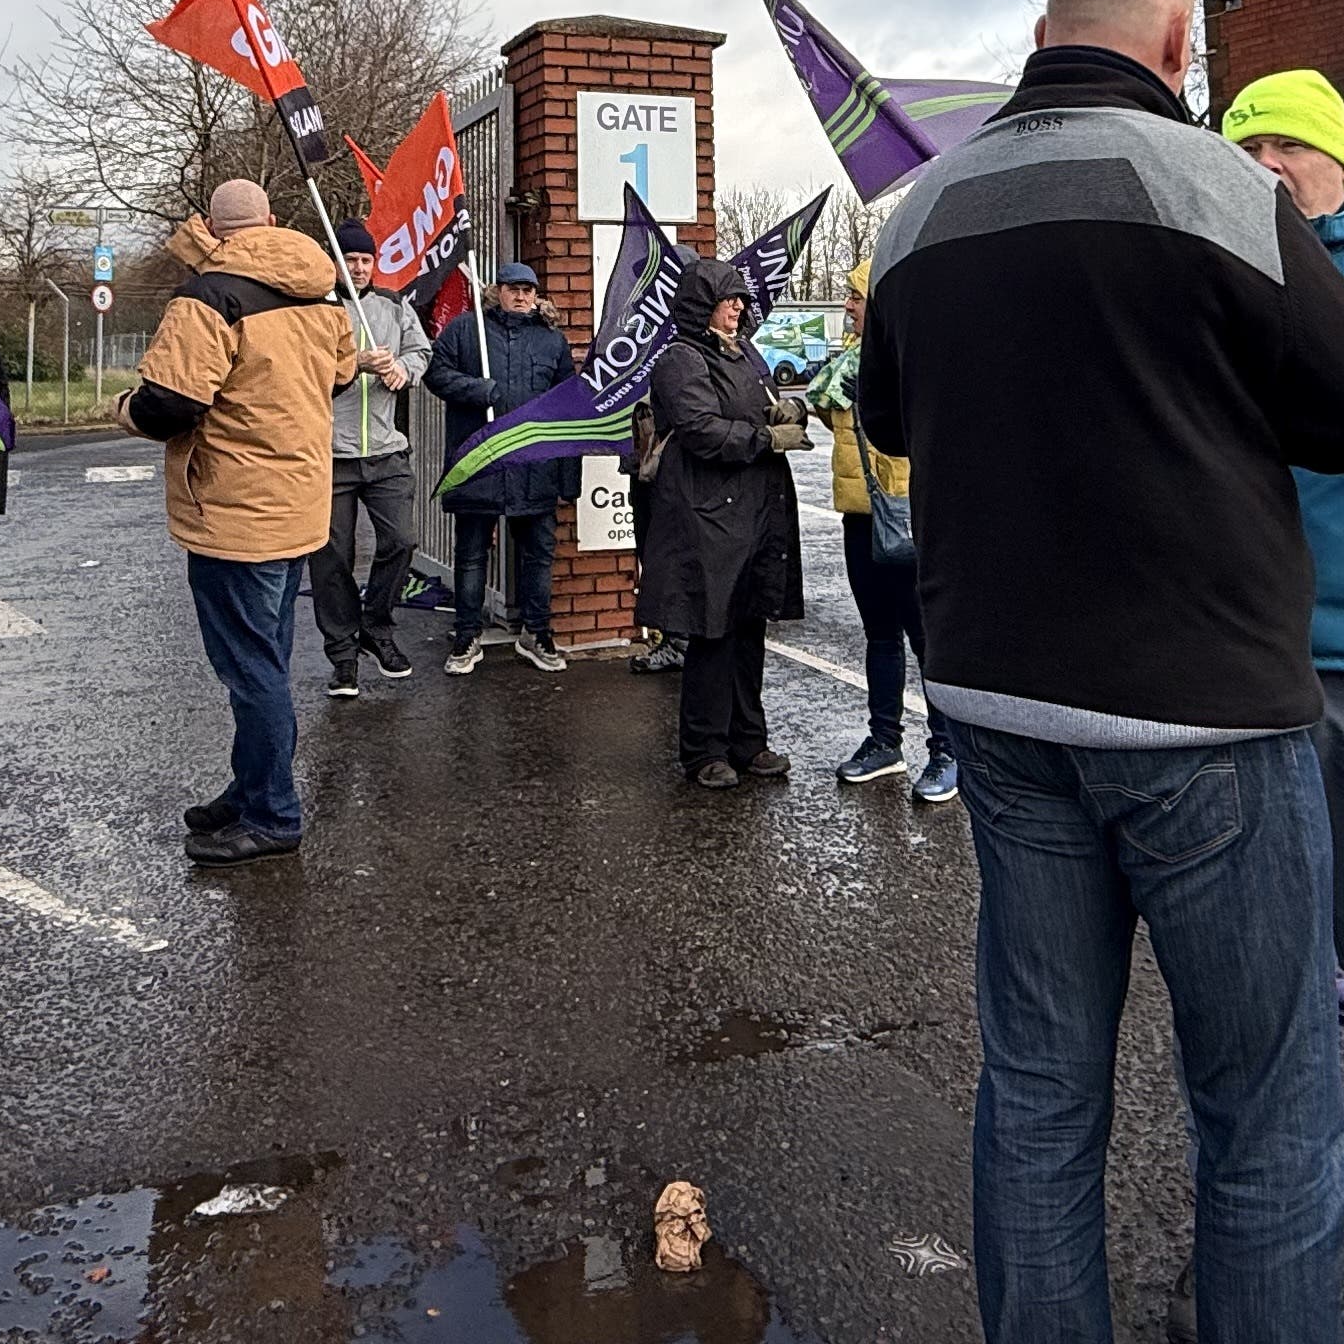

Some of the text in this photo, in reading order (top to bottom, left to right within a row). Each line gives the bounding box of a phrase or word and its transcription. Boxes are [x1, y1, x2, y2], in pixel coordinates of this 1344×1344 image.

[596, 102, 678, 133] GATE
[619, 143, 649, 207] 1
[98, 291, 107, 305] 5
[607, 529, 635, 542] ope
